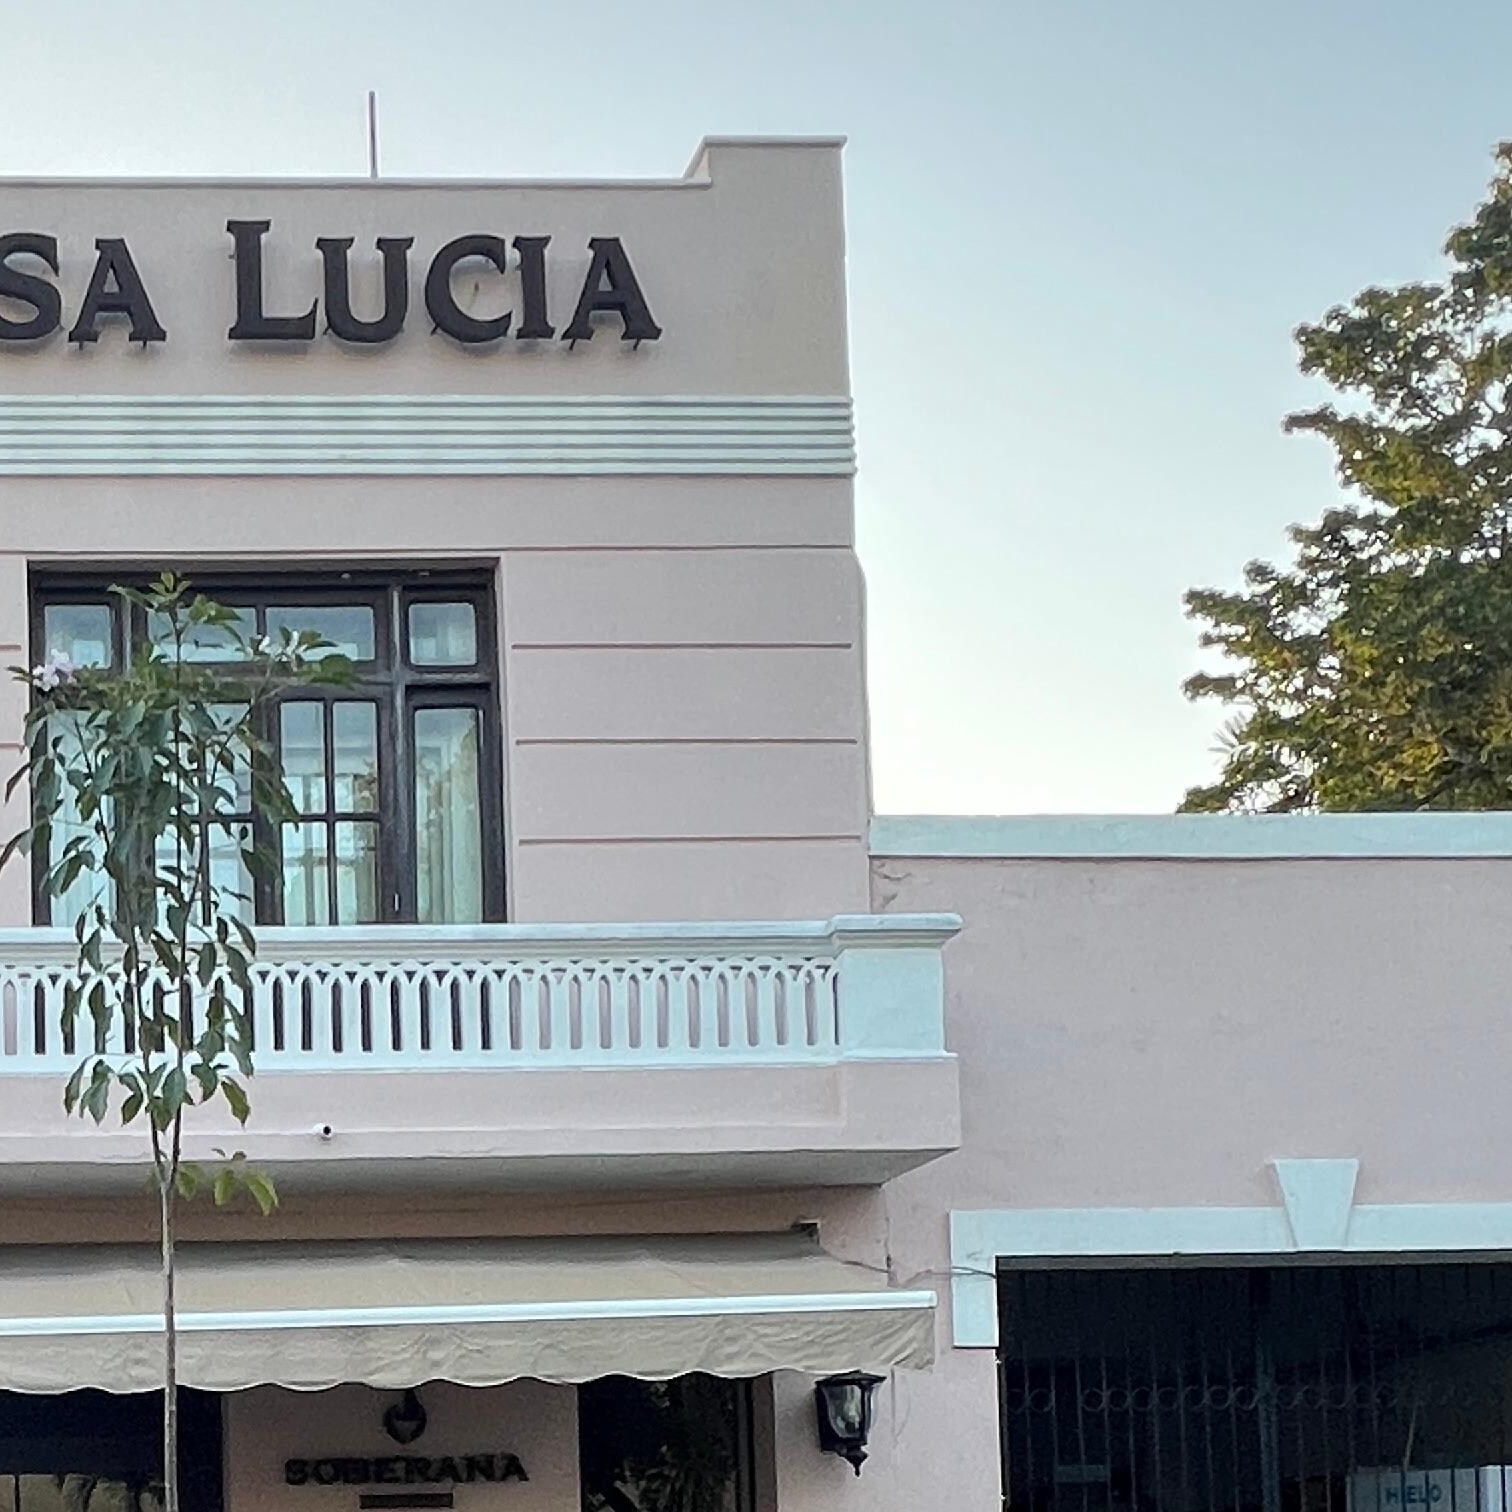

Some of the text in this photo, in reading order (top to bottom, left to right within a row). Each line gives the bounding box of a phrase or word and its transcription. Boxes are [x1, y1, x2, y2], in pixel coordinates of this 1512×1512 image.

[226, 218, 663, 344] LUCIA
[284, 1453, 530, 1485] SOBERANA
[1384, 1484, 1442, 1505] HELO
